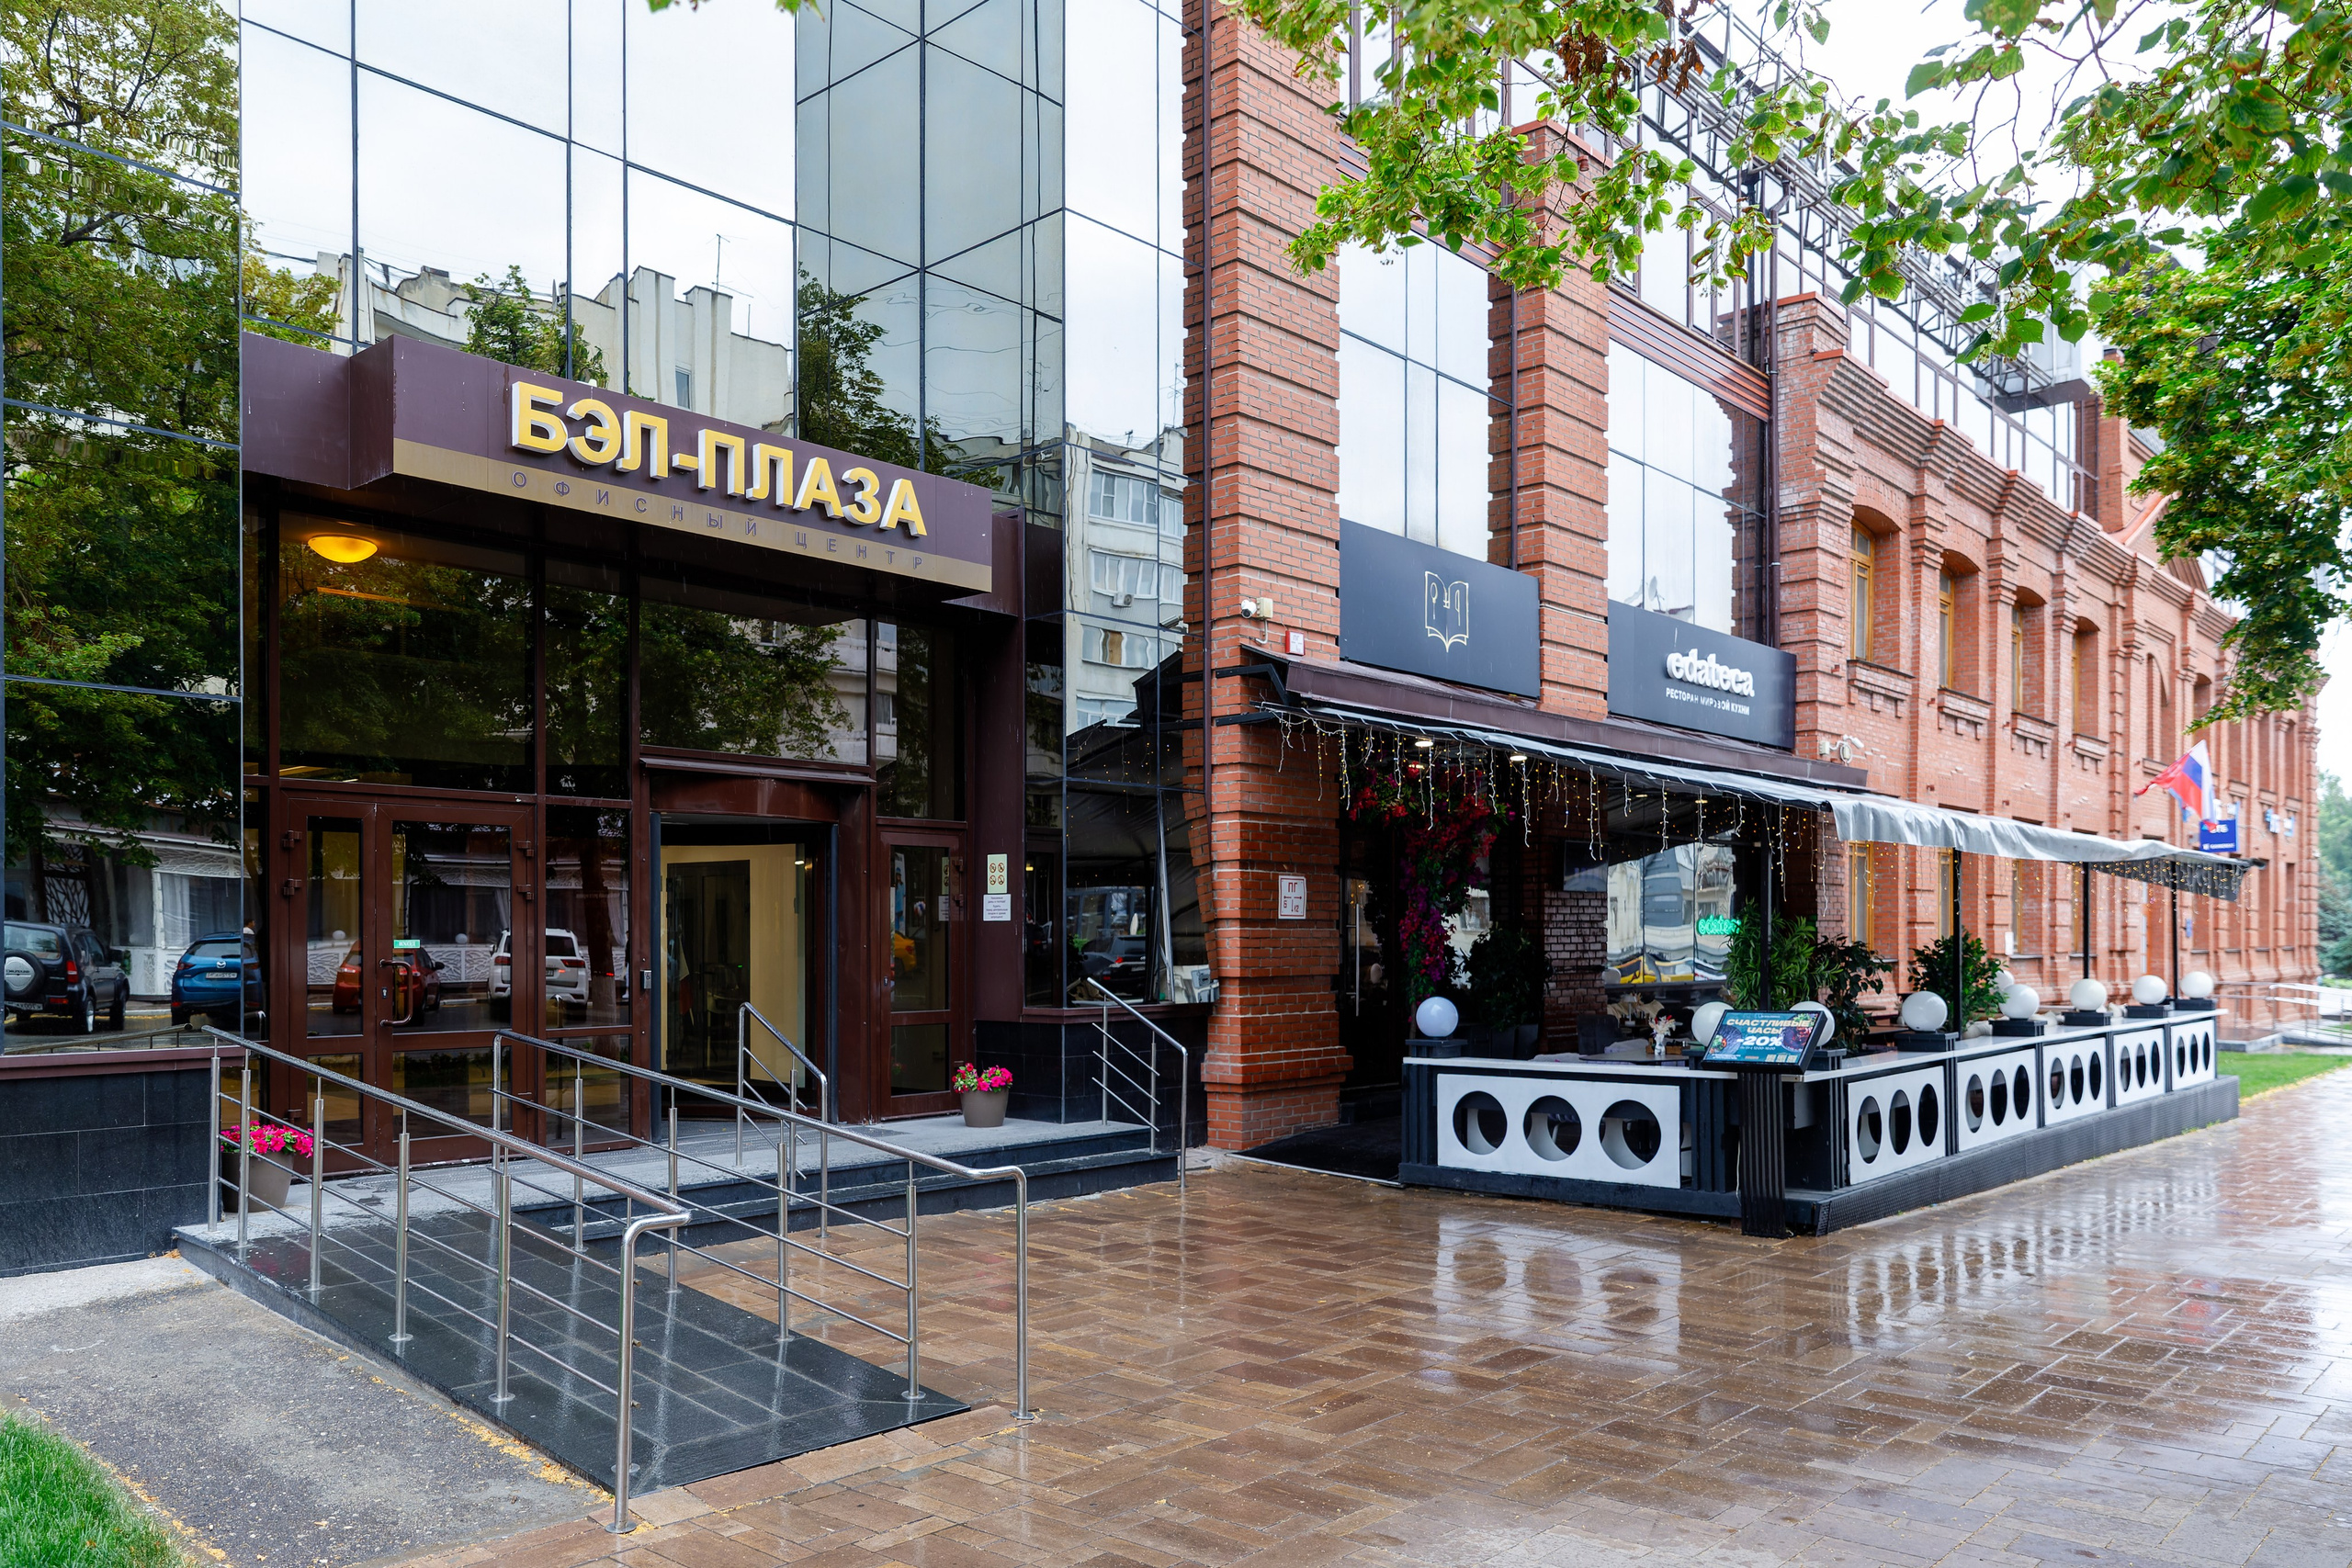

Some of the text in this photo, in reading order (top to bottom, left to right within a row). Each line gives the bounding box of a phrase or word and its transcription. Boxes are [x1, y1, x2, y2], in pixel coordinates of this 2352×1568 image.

[511, 380, 928, 537] БЭЛ-ПЛАЗА
[511, 470, 922, 570] ОФИСНЫЙ ЦЕНТР
[1666, 687, 1699, 704] РЕСТОРАН
[1731, 703, 1750, 716] КУХНИ
[1288, 882, 1298, 893] ПГ
[1726, 1019, 1811, 1027] СЧАСТЛИВЫЕ
[1736, 1036, 1783, 1047] -20%
